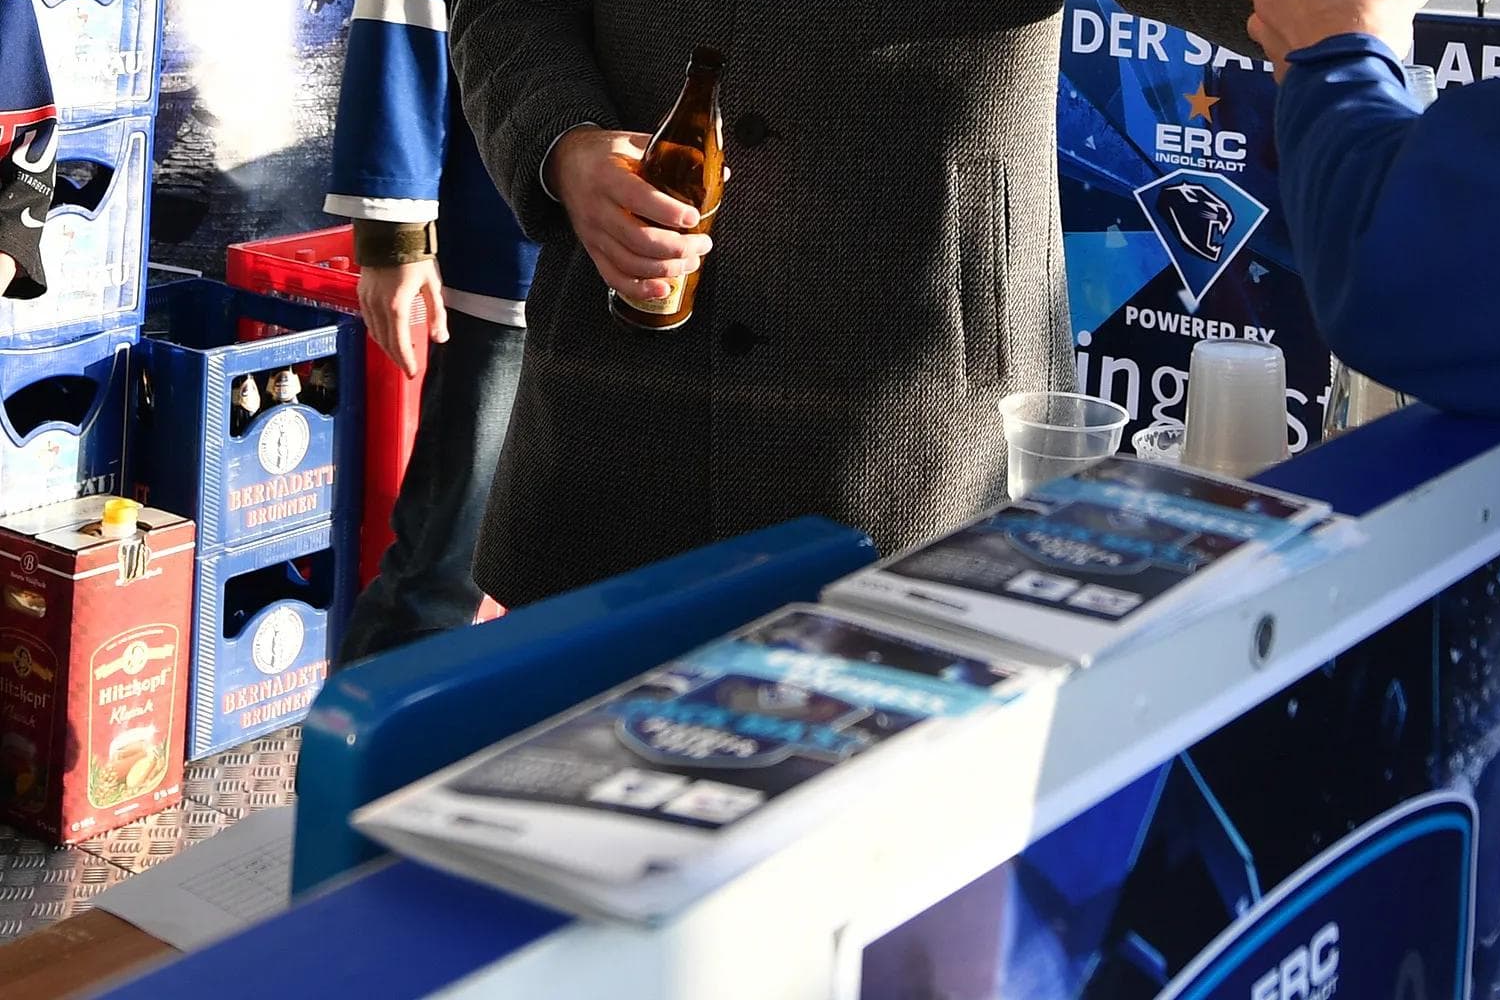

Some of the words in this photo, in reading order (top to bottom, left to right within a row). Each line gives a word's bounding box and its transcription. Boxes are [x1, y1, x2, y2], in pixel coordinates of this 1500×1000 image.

[1071, 8, 1170, 62] DER
[1155, 123, 1247, 160] ERC
[1155, 151, 1247, 173] INGOLSTADT
[1125, 305, 1236, 341] POWERED
[229, 463, 337, 512] BERNADETT
[245, 492, 318, 528] BRUNNEN
[222, 659, 332, 715] BERNADETT
